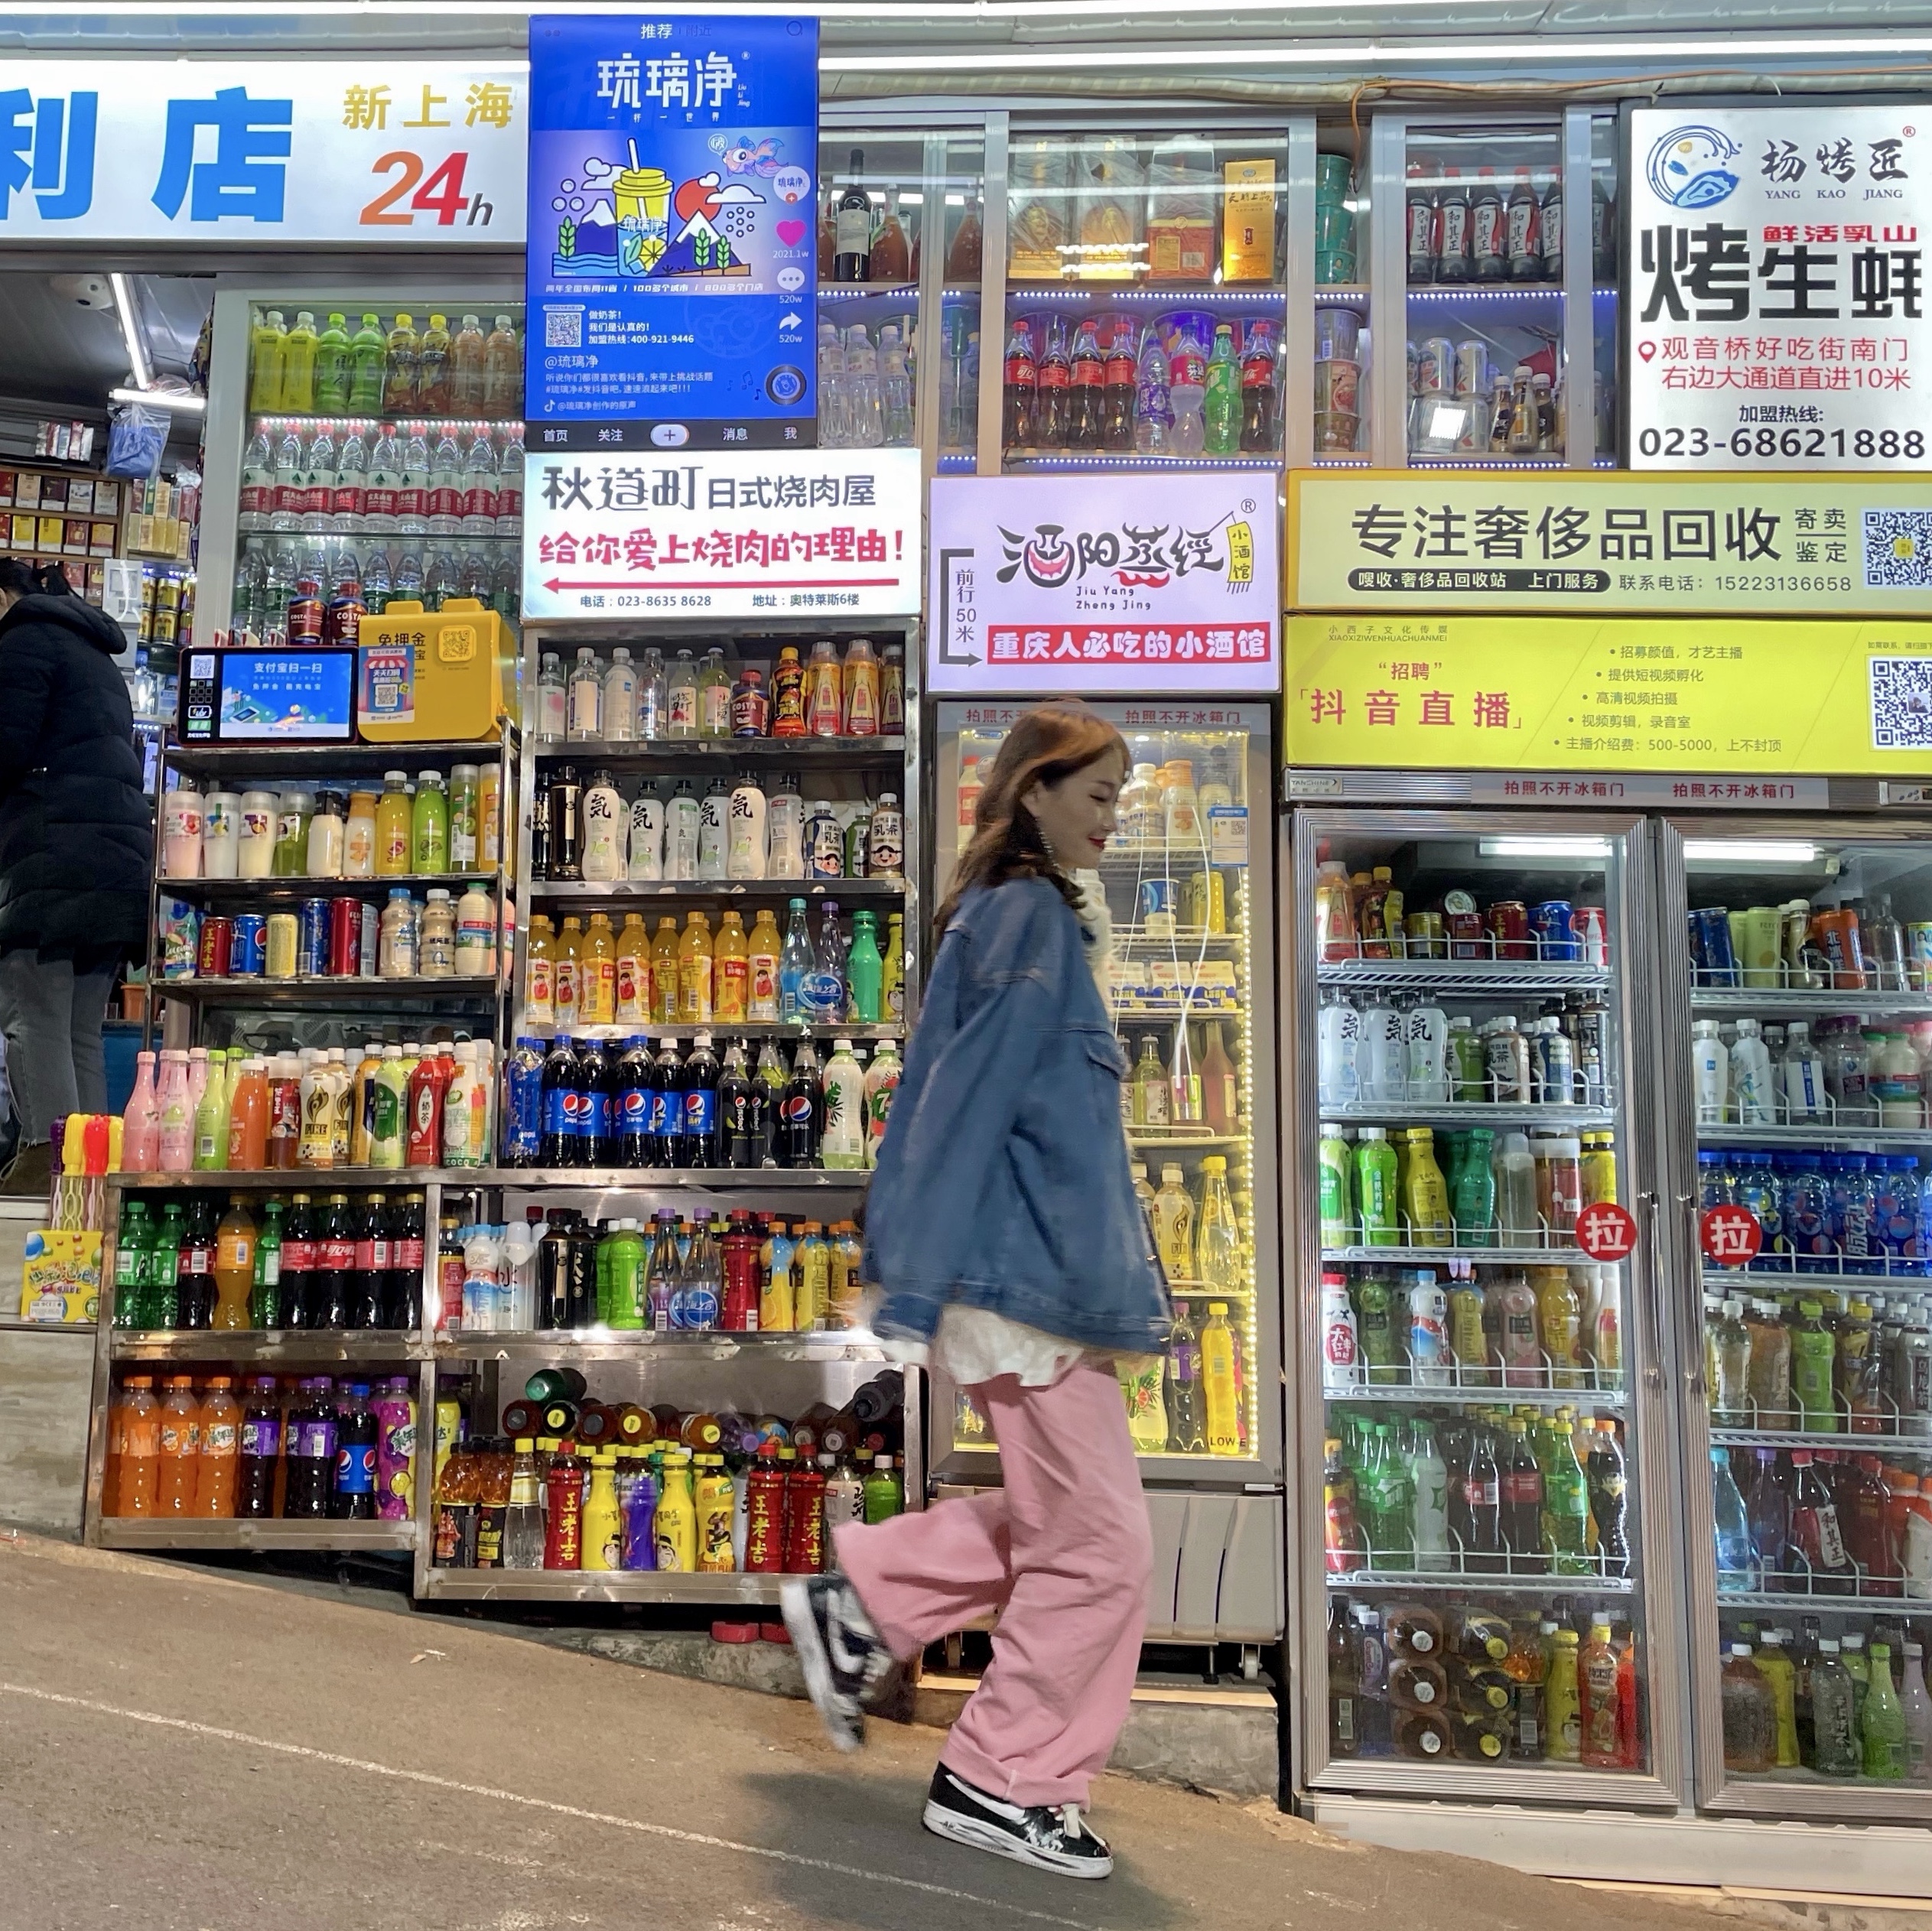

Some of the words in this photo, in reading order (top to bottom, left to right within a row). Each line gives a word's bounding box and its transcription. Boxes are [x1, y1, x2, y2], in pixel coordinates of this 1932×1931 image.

[640, 23, 673, 39] 推荐
[597, 50, 737, 109] 琉璃净
[343, 83, 514, 130] 新上海
[359, 150, 494, 227] 24h
[1764, 189, 1801, 200] YANG
[1817, 189, 1846, 200] KAO
[1862, 189, 1904, 200] JIANG
[1762, 224, 1917, 242] 鲜活乳山
[772, 250, 809, 259] 2021.1w
[1640, 223, 1923, 323] 烤生蚝
[779, 294, 802, 304] 520w
[779, 334, 802, 343] 520w
[1661, 336, 1908, 361] 观音桥好吃街南门
[545, 354, 599, 369] @琉璃净
[1661, 365, 1911, 391] 右边大通道直进10米
[542, 428, 568, 443] 首页
[598, 427, 624, 442] 关注
[722, 427, 749, 441] 消息
[784, 426, 798, 440] 我
[1638, 427, 1926, 459] 023-68621888
[707, 473, 877, 509] 日式烧肉屋
[1794, 507, 1847, 530] 寄卖
[1351, 503, 1782, 562] 专注奢侈品回收
[1231, 528, 1251, 581] 小酒馆
[1795, 541, 1848, 564] 鉴定
[1527, 571, 1599, 590] 上门服务
[1076, 586, 1097, 597] Jiu
[1103, 586, 1134, 597] Yang
[681, 596, 712, 607] 8628
[955, 569, 977, 643] 前行50米
[1076, 600, 1115, 611] Zheng
[1122, 600, 1151, 611] Jing
[1328, 625, 1449, 635] 小西子文化传媒
[1328, 634, 1448, 642] XIAOXIZIWENHUACHUANMEI
[378, 632, 426, 647] 免押金
[991, 629, 1267, 659] 重庆人必吃的小酒馆
[253, 662, 323, 674] 支付宝扫一扫
[1608, 668, 1704, 683] 提供短视频孵化
[732, 701, 757, 711] COSTA
[1595, 691, 1678, 706] 高清视频拍摄
[1125, 709, 1241, 724] 拍照不开冰箱门
[1503, 780, 1625, 797] 拍照不开冰箱门
[1672, 782, 1795, 799] 拍照不开冰箱门
[203, 928, 215, 969] 王老吉
[421, 1100, 431, 1125] 奶茶
[304, 1123, 328, 1135] FIRE
[1585, 1211, 1629, 1253] 拉
[1709, 1214, 1754, 1256] 拉
[559, 1492, 578, 1562] 王老吉
[749, 1494, 770, 1565] 王老吉
[805, 1497, 822, 1565] 王老吉
